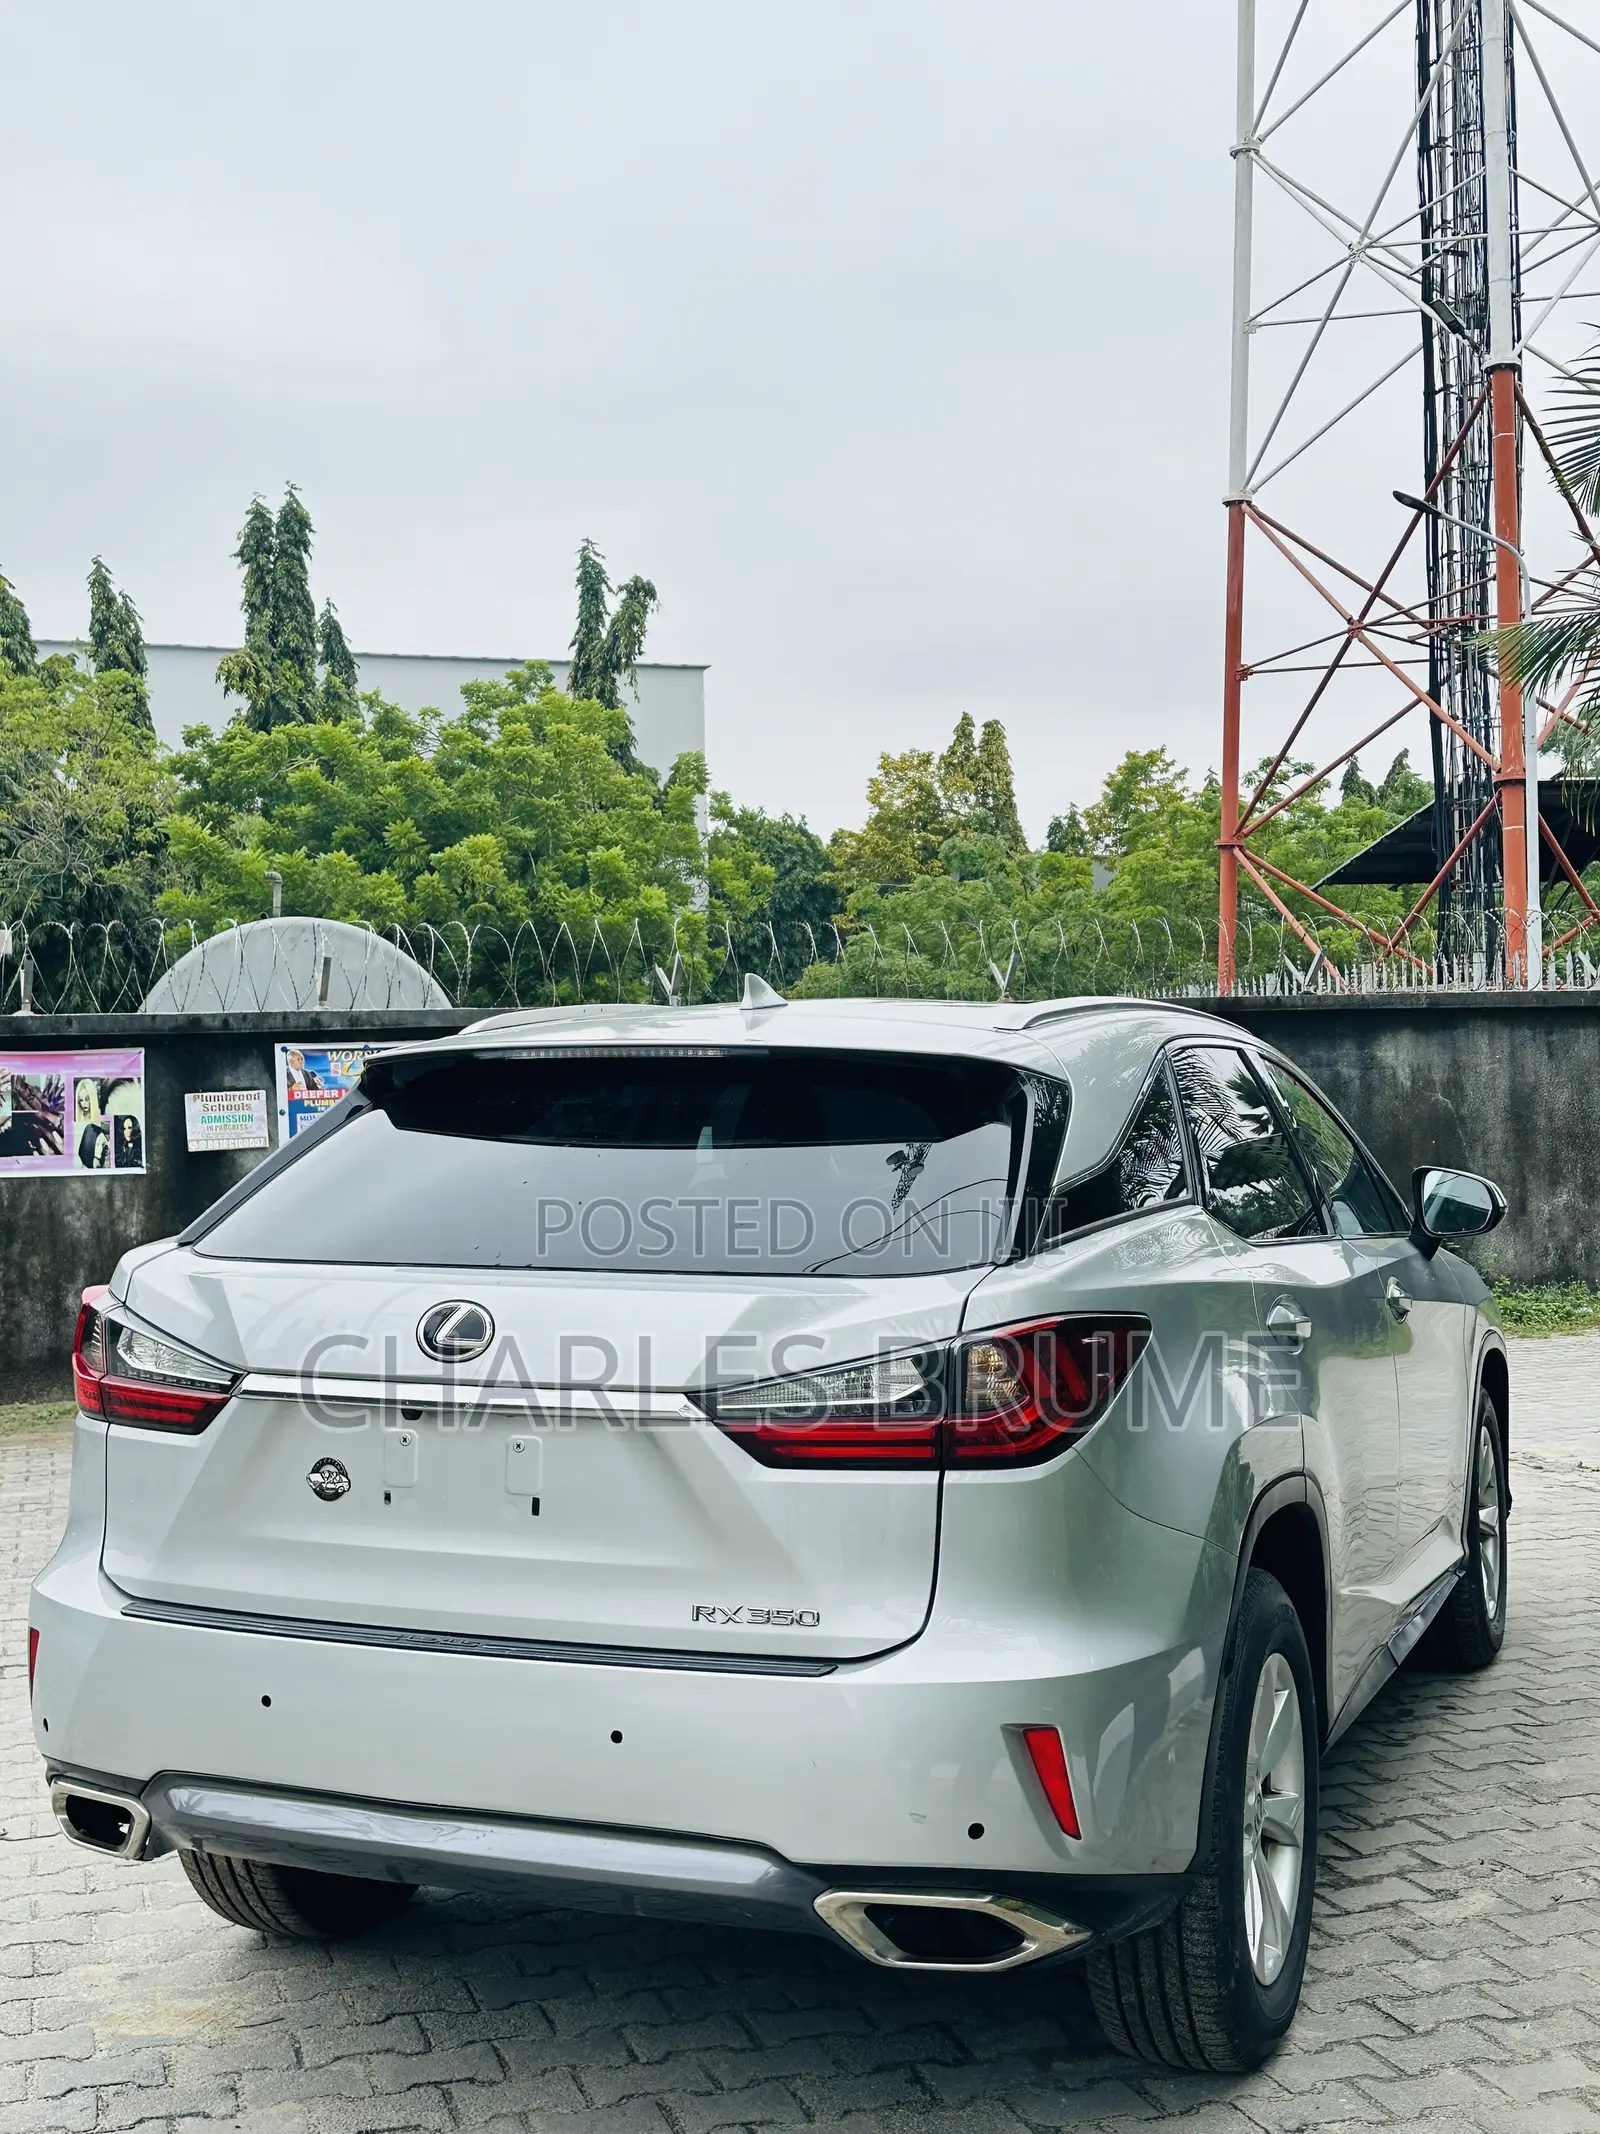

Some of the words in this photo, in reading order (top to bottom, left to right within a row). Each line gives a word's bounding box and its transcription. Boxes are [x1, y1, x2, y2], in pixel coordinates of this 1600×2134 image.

[293, 1090, 339, 1099] DEEPER
[202, 1103, 252, 1113] Schools
[200, 1114, 254, 1125] ADMISSION
